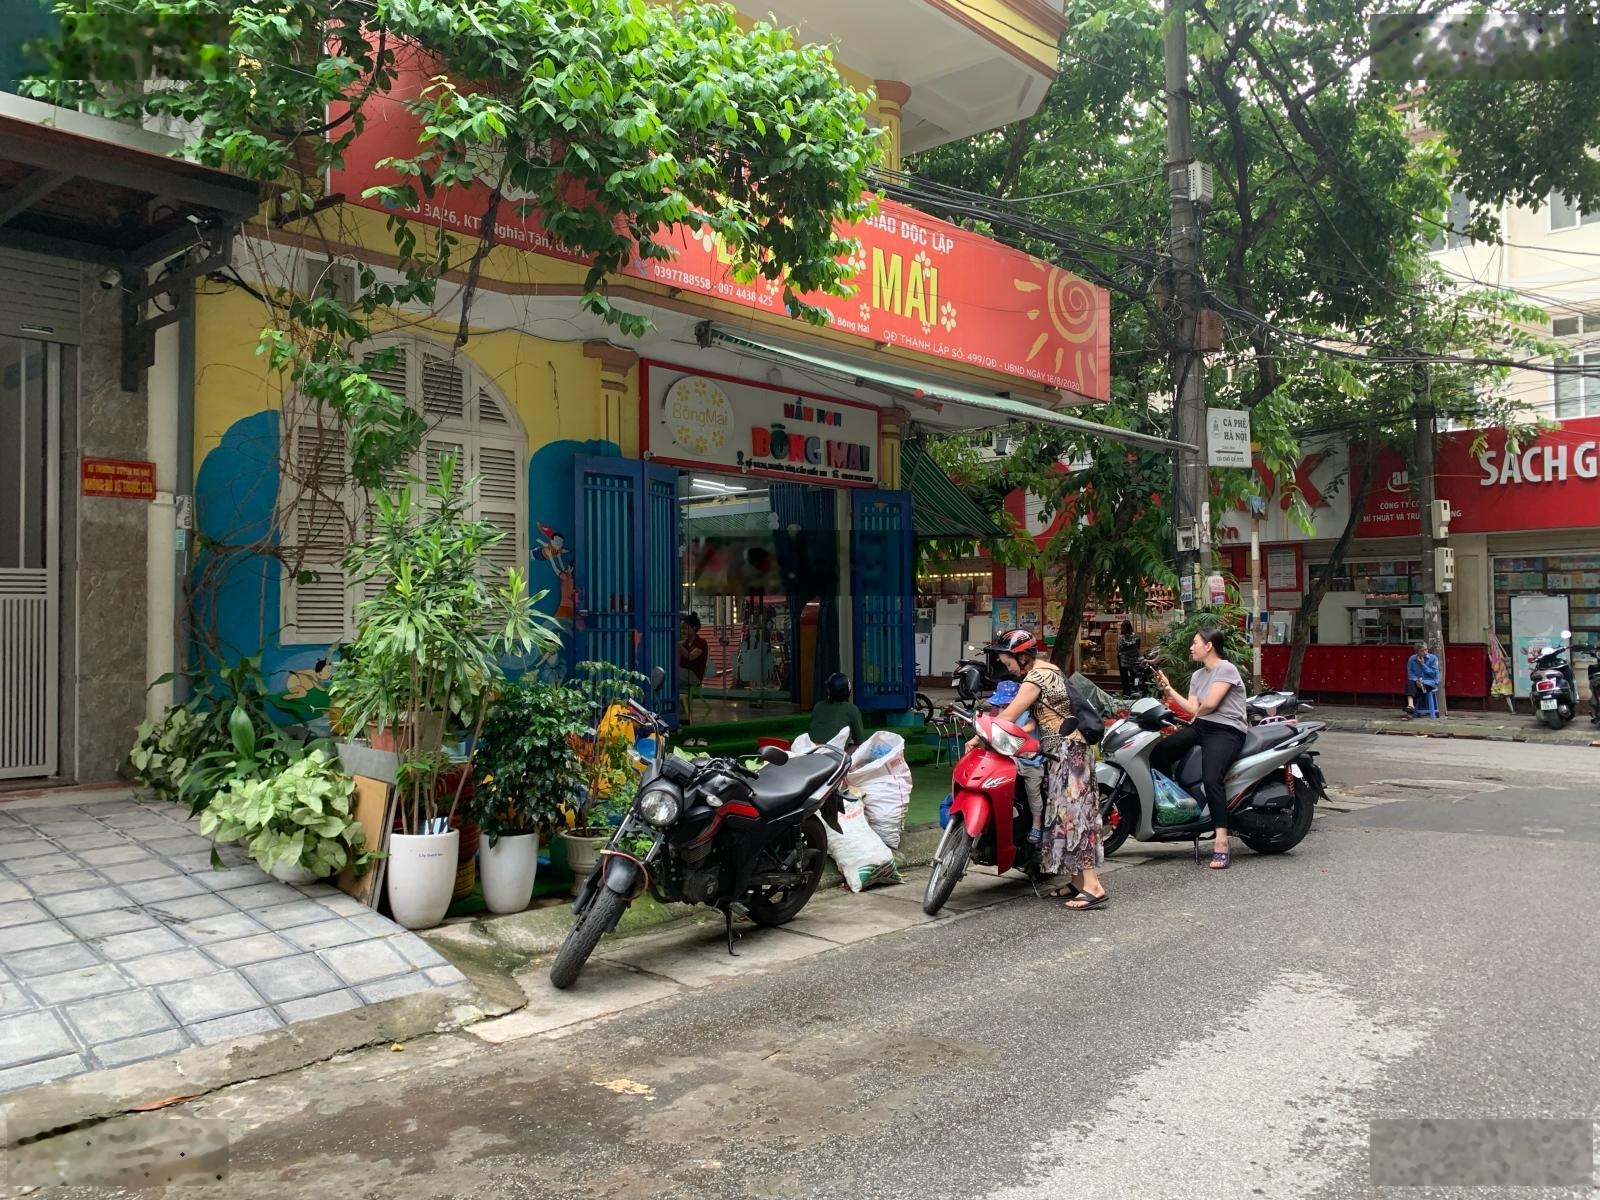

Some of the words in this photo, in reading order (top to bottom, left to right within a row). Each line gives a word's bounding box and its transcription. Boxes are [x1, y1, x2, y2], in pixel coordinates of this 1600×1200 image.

[901, 221, 928, 246] ĐỘC
[932, 231, 954, 255] LẬP
[654, 264, 712, 291] 0397788558
[718, 282, 734, 295] 097
[736, 289, 757, 302] 4438
[758, 294, 774, 307] 425
[871, 246, 939, 326] MAI
[900, 334, 931, 350] THÀNH
[967, 353, 998, 368] 499/QĐ
[1004, 362, 1025, 375] UBND
[1026, 368, 1046, 380] NGÀY
[1047, 374, 1080, 391] 18/8/2020
[752, 423, 822, 465] BÔNG
[826, 439, 871, 472] MAI
[1224, 429, 1234, 441] HÀ
[1573, 441, 1599, 479] G
